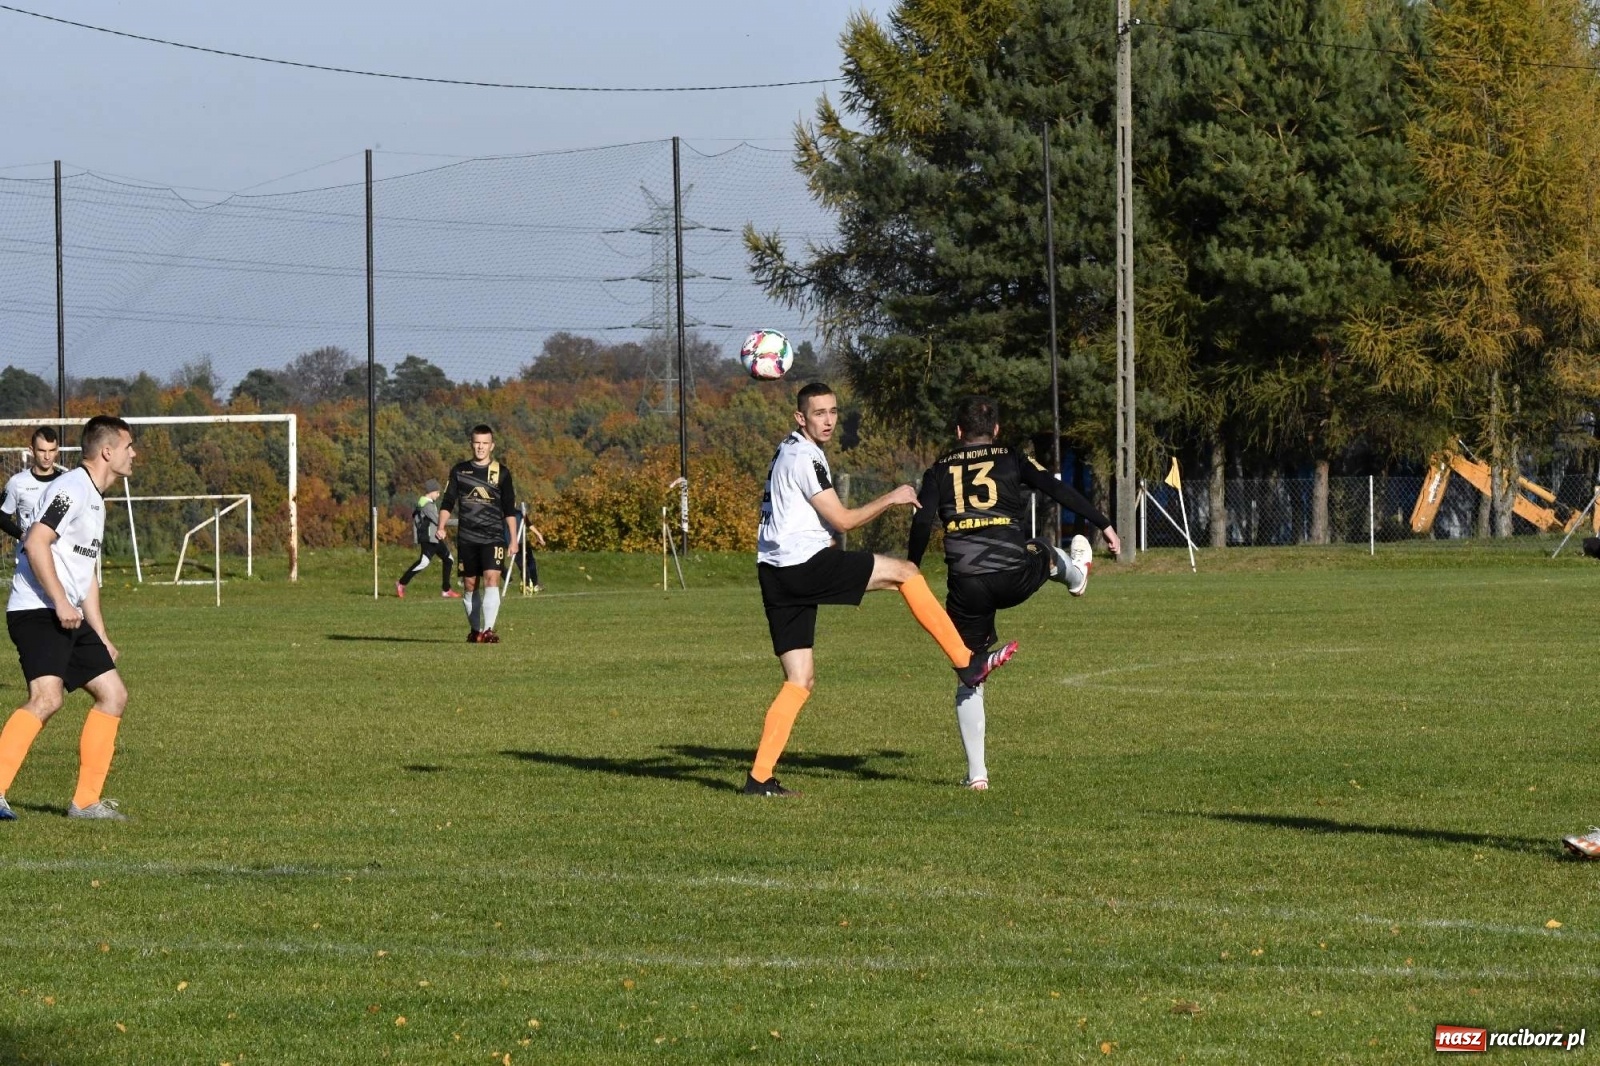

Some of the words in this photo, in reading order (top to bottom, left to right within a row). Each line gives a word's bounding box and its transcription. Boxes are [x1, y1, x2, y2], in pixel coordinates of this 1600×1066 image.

[966, 448, 988, 459] NOWA
[949, 460, 998, 514] 13
[493, 546, 504, 560] 18
